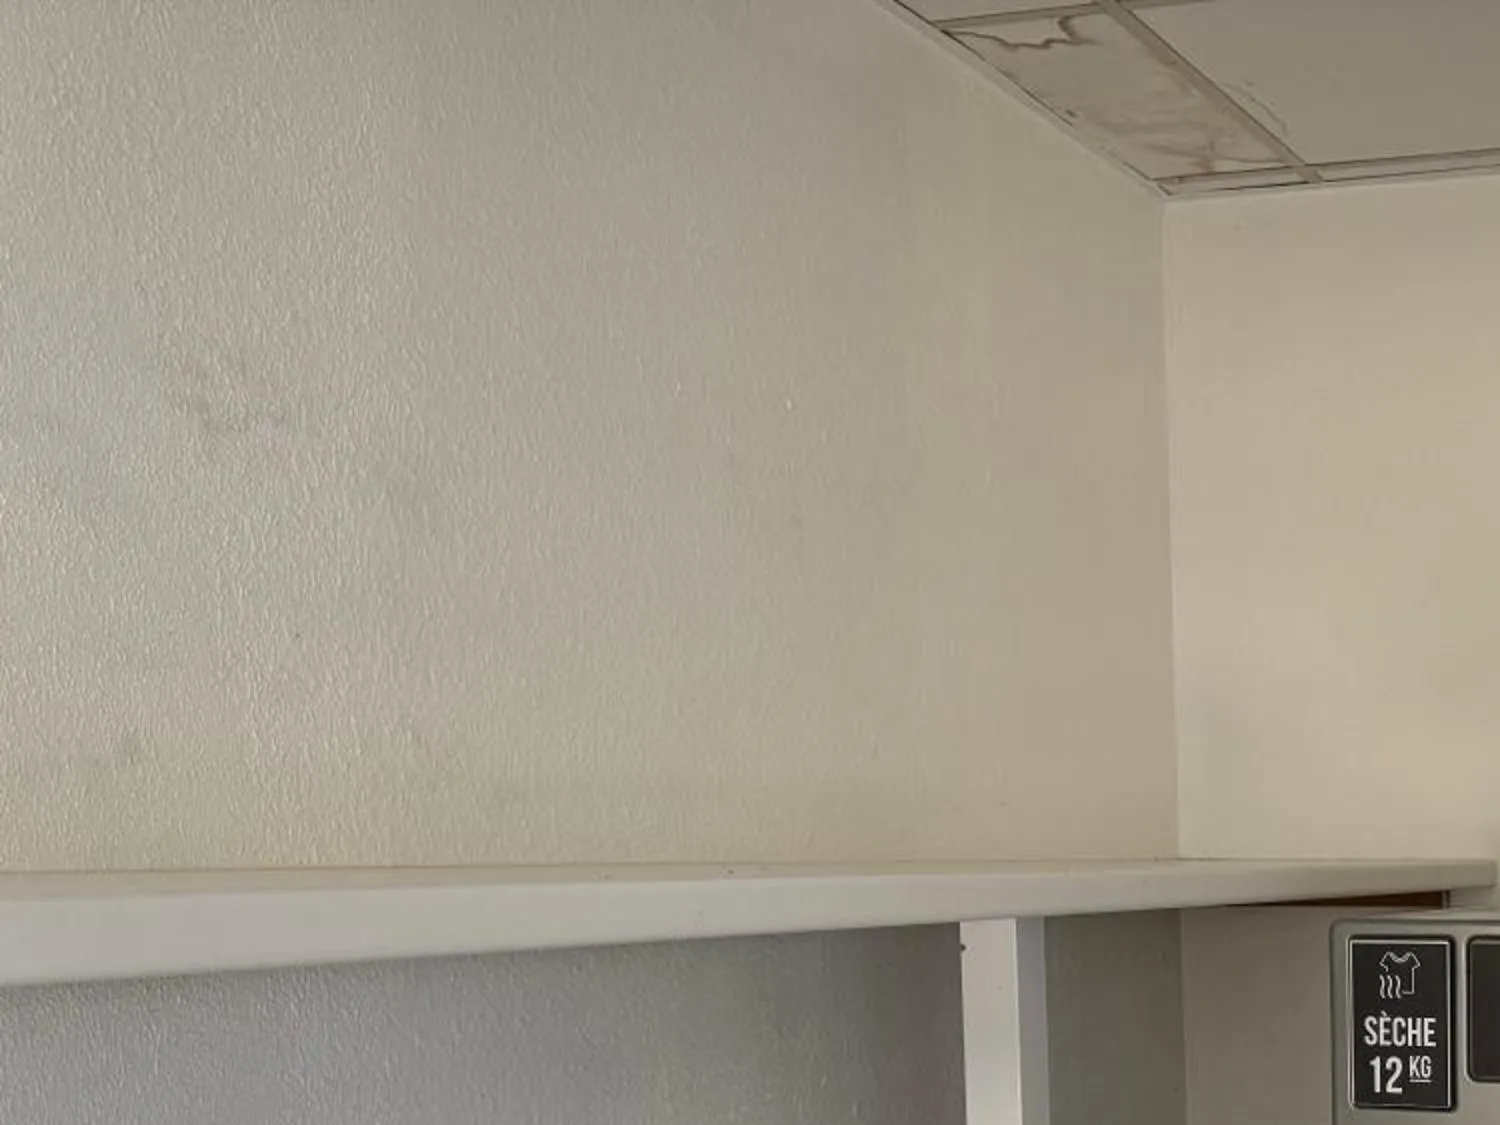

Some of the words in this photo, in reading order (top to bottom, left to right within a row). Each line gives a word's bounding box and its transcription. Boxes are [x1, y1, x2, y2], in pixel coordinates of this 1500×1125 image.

[1364, 1010, 1437, 1047] SÈCHE
[1369, 1056, 1403, 1094] 12
[1409, 1055, 1432, 1079] KG
